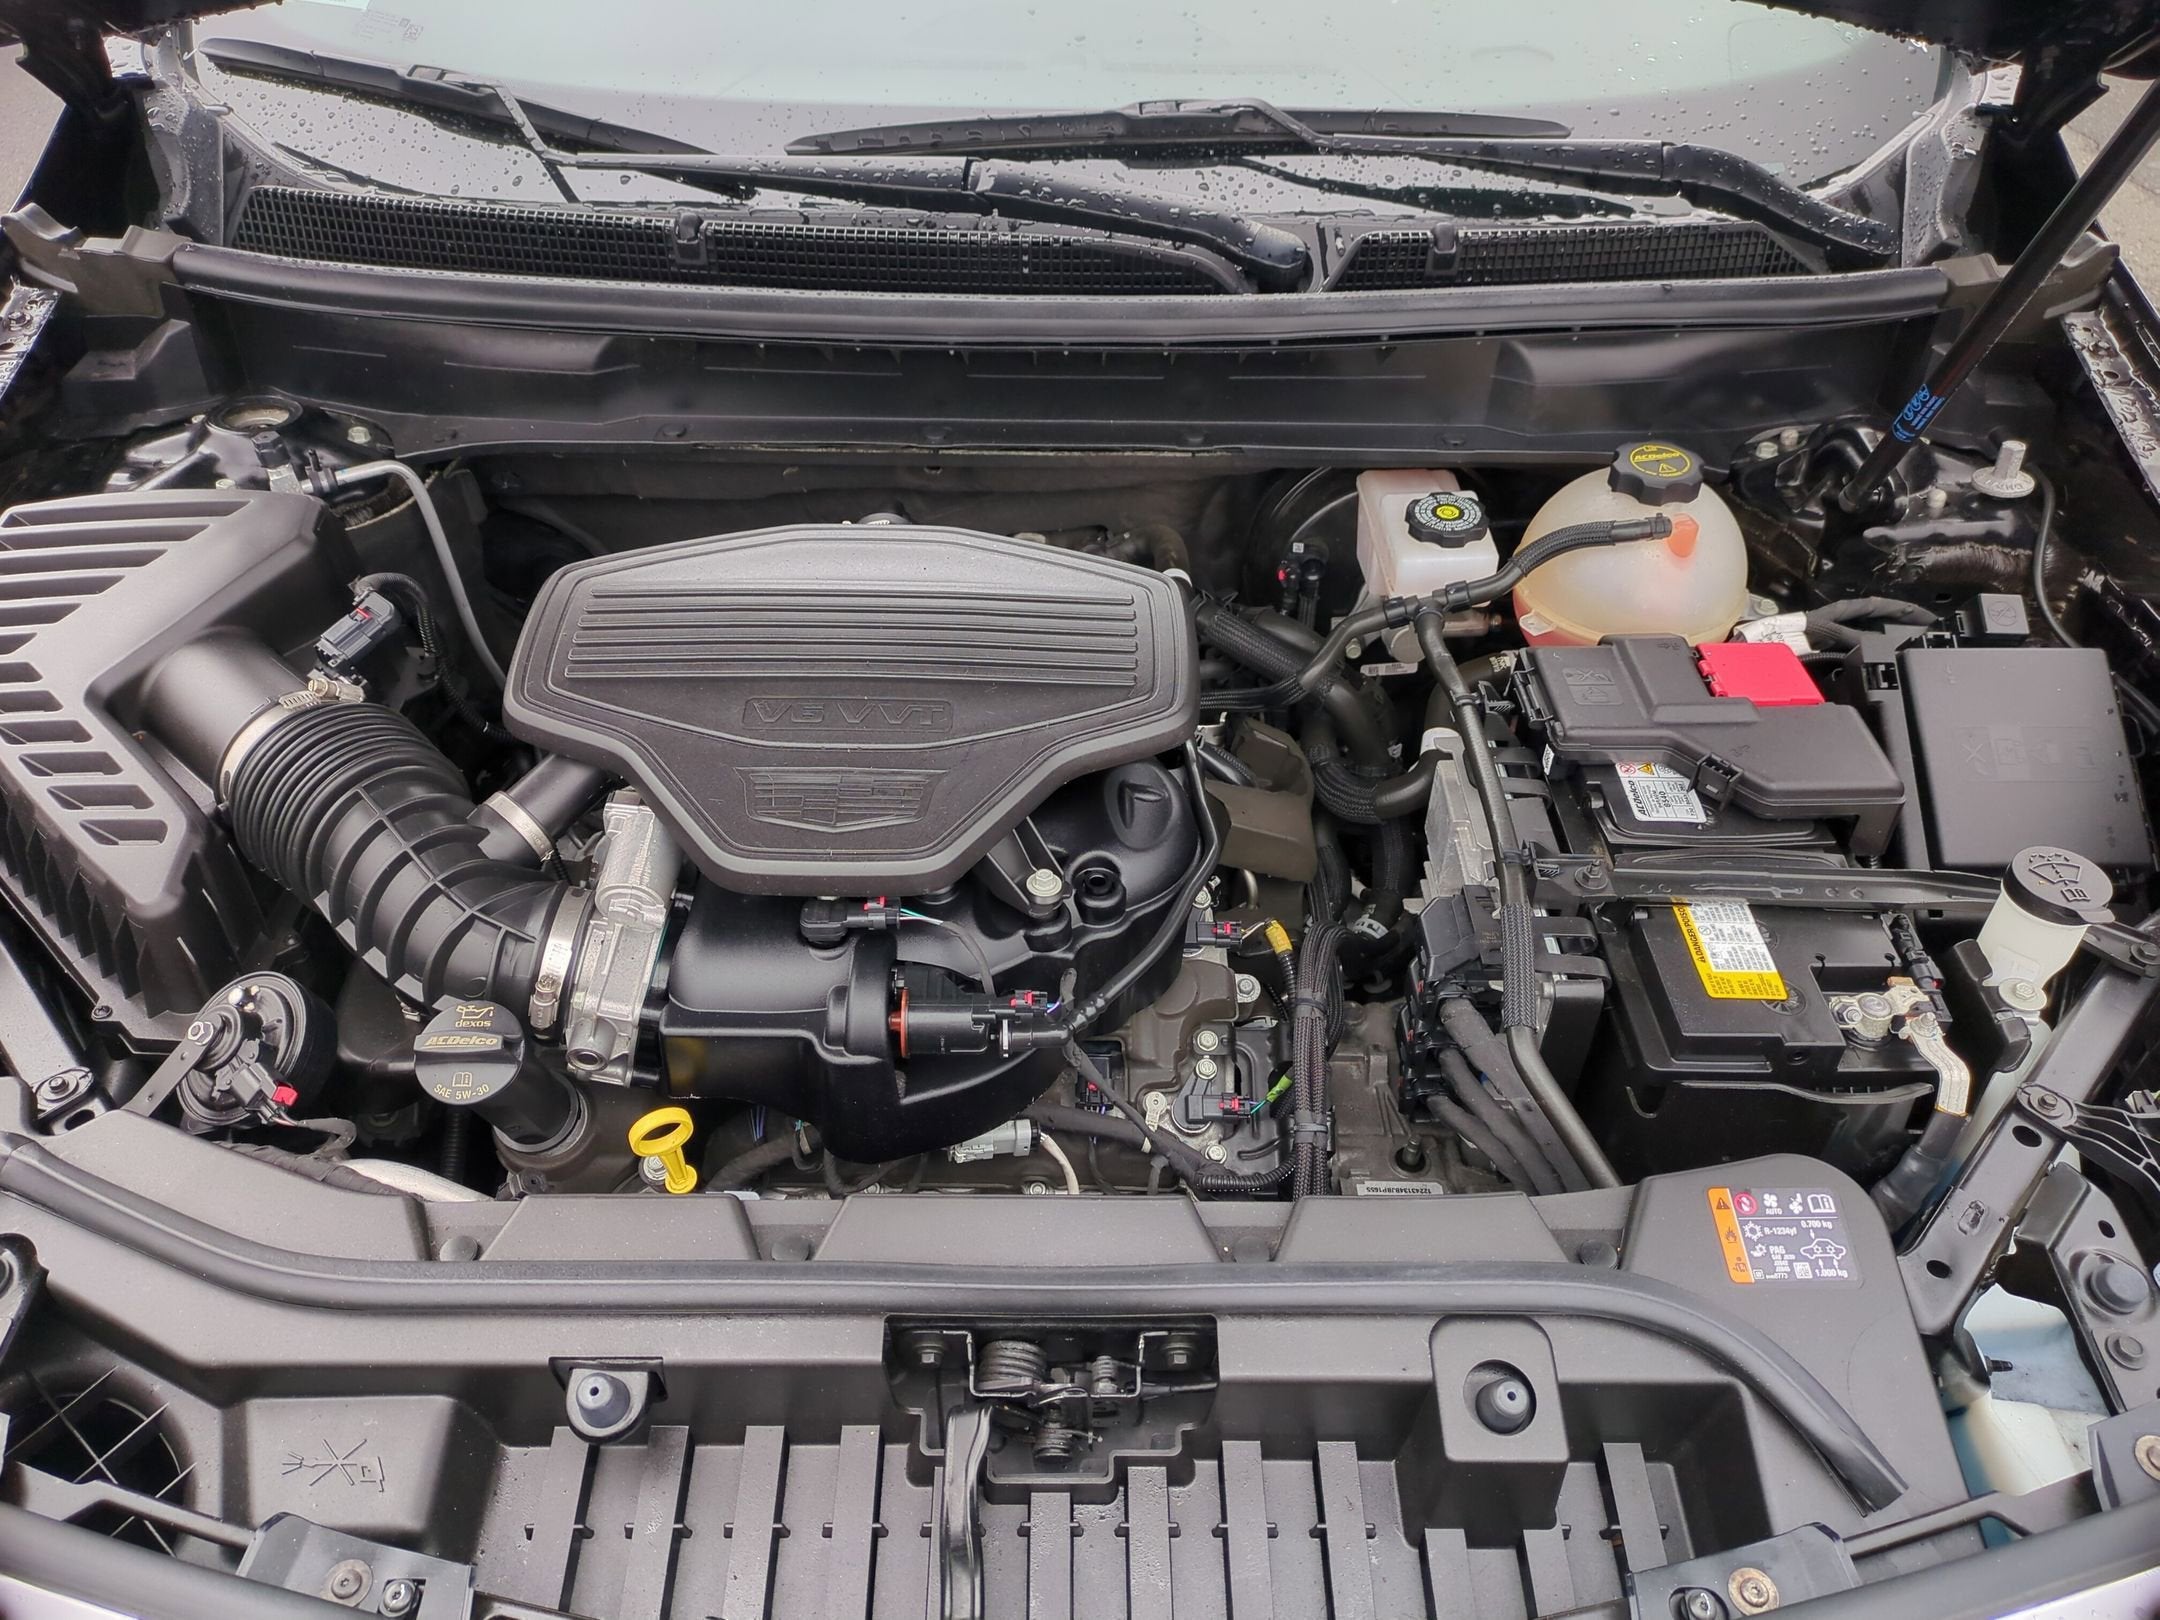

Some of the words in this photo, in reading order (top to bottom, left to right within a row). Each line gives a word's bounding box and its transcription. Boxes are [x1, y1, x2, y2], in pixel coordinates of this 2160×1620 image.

[753, 702, 825, 723] V6
[837, 703, 945, 725] VVT
[1628, 780, 1647, 816] ACDelco
[455, 1019, 492, 1028] dexos
[424, 1035, 498, 1046] ACDelco
[433, 1084, 452, 1099] SAE
[455, 1084, 490, 1100] 5W-30
[1822, 1220, 1833, 1229] kg
[1769, 1245, 1786, 1255] PAG
[1837, 1269, 1848, 1278] kg
